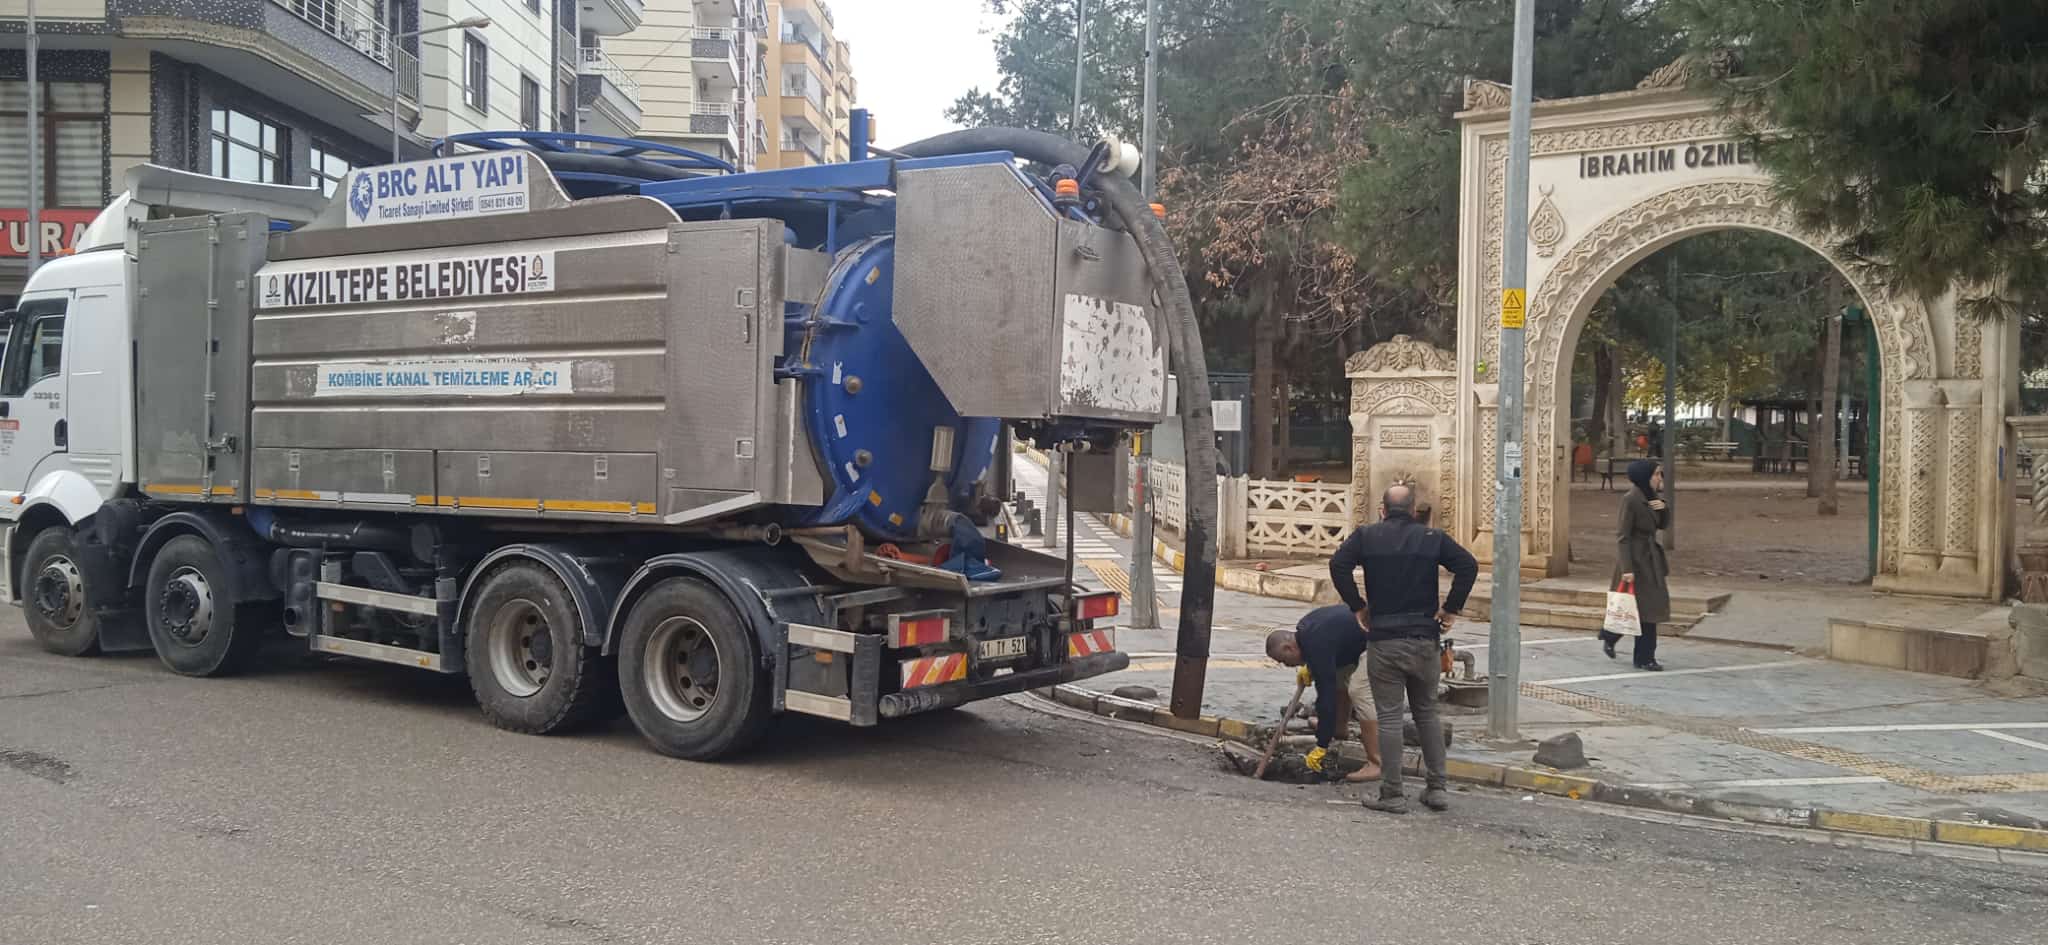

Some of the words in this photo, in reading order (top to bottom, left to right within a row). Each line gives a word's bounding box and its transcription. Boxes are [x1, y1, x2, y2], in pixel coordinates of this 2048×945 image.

[377, 168, 417, 198] BRC
[424, 163, 465, 194] ALT
[472, 155, 523, 188] YAPI
[1579, 146, 1675, 179] İBRAHİM
[378, 204, 401, 219] Ticaret
[402, 201, 424, 219] Sanayi
[425, 198, 450, 216] Limited
[451, 196, 474, 216] Şirketi
[284, 266, 388, 305] KIZILTEPE
[328, 369, 383, 387] KOMBİNE
[386, 371, 430, 387] KANAL
[432, 368, 510, 386] TEMİZLEME
